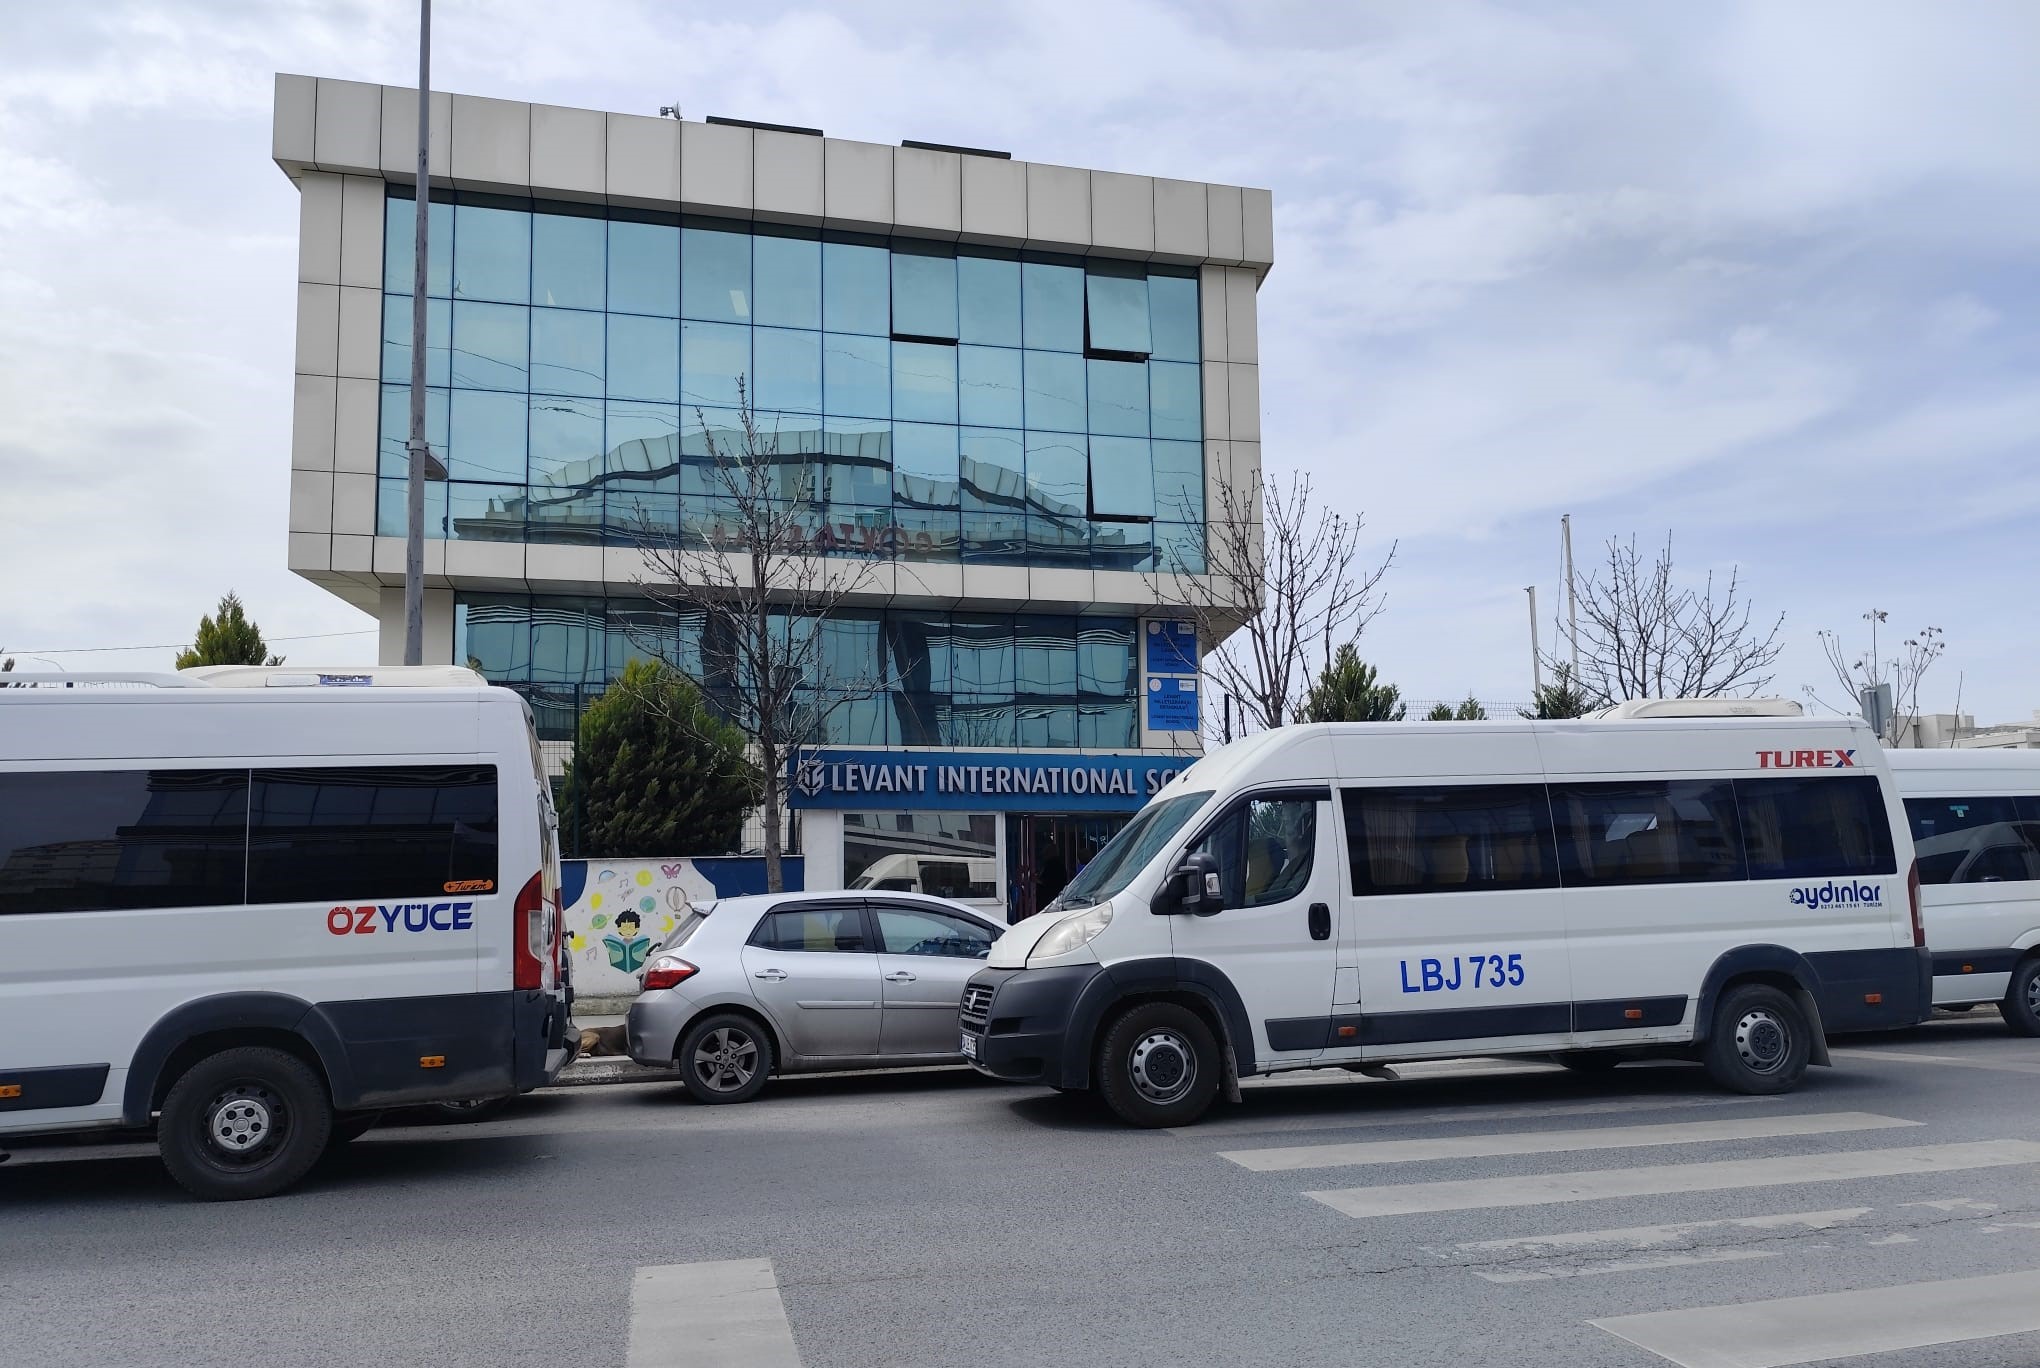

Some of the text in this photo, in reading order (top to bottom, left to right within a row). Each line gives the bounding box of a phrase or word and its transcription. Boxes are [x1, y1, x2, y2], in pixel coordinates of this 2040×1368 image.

[1755, 749, 1857, 768] TUREX
[831, 764, 1182, 795] LEVANT INTERNATIONAL SC
[327, 902, 474, 936] ÖZYÜCE
[1400, 954, 1525, 993] LBJ 735
